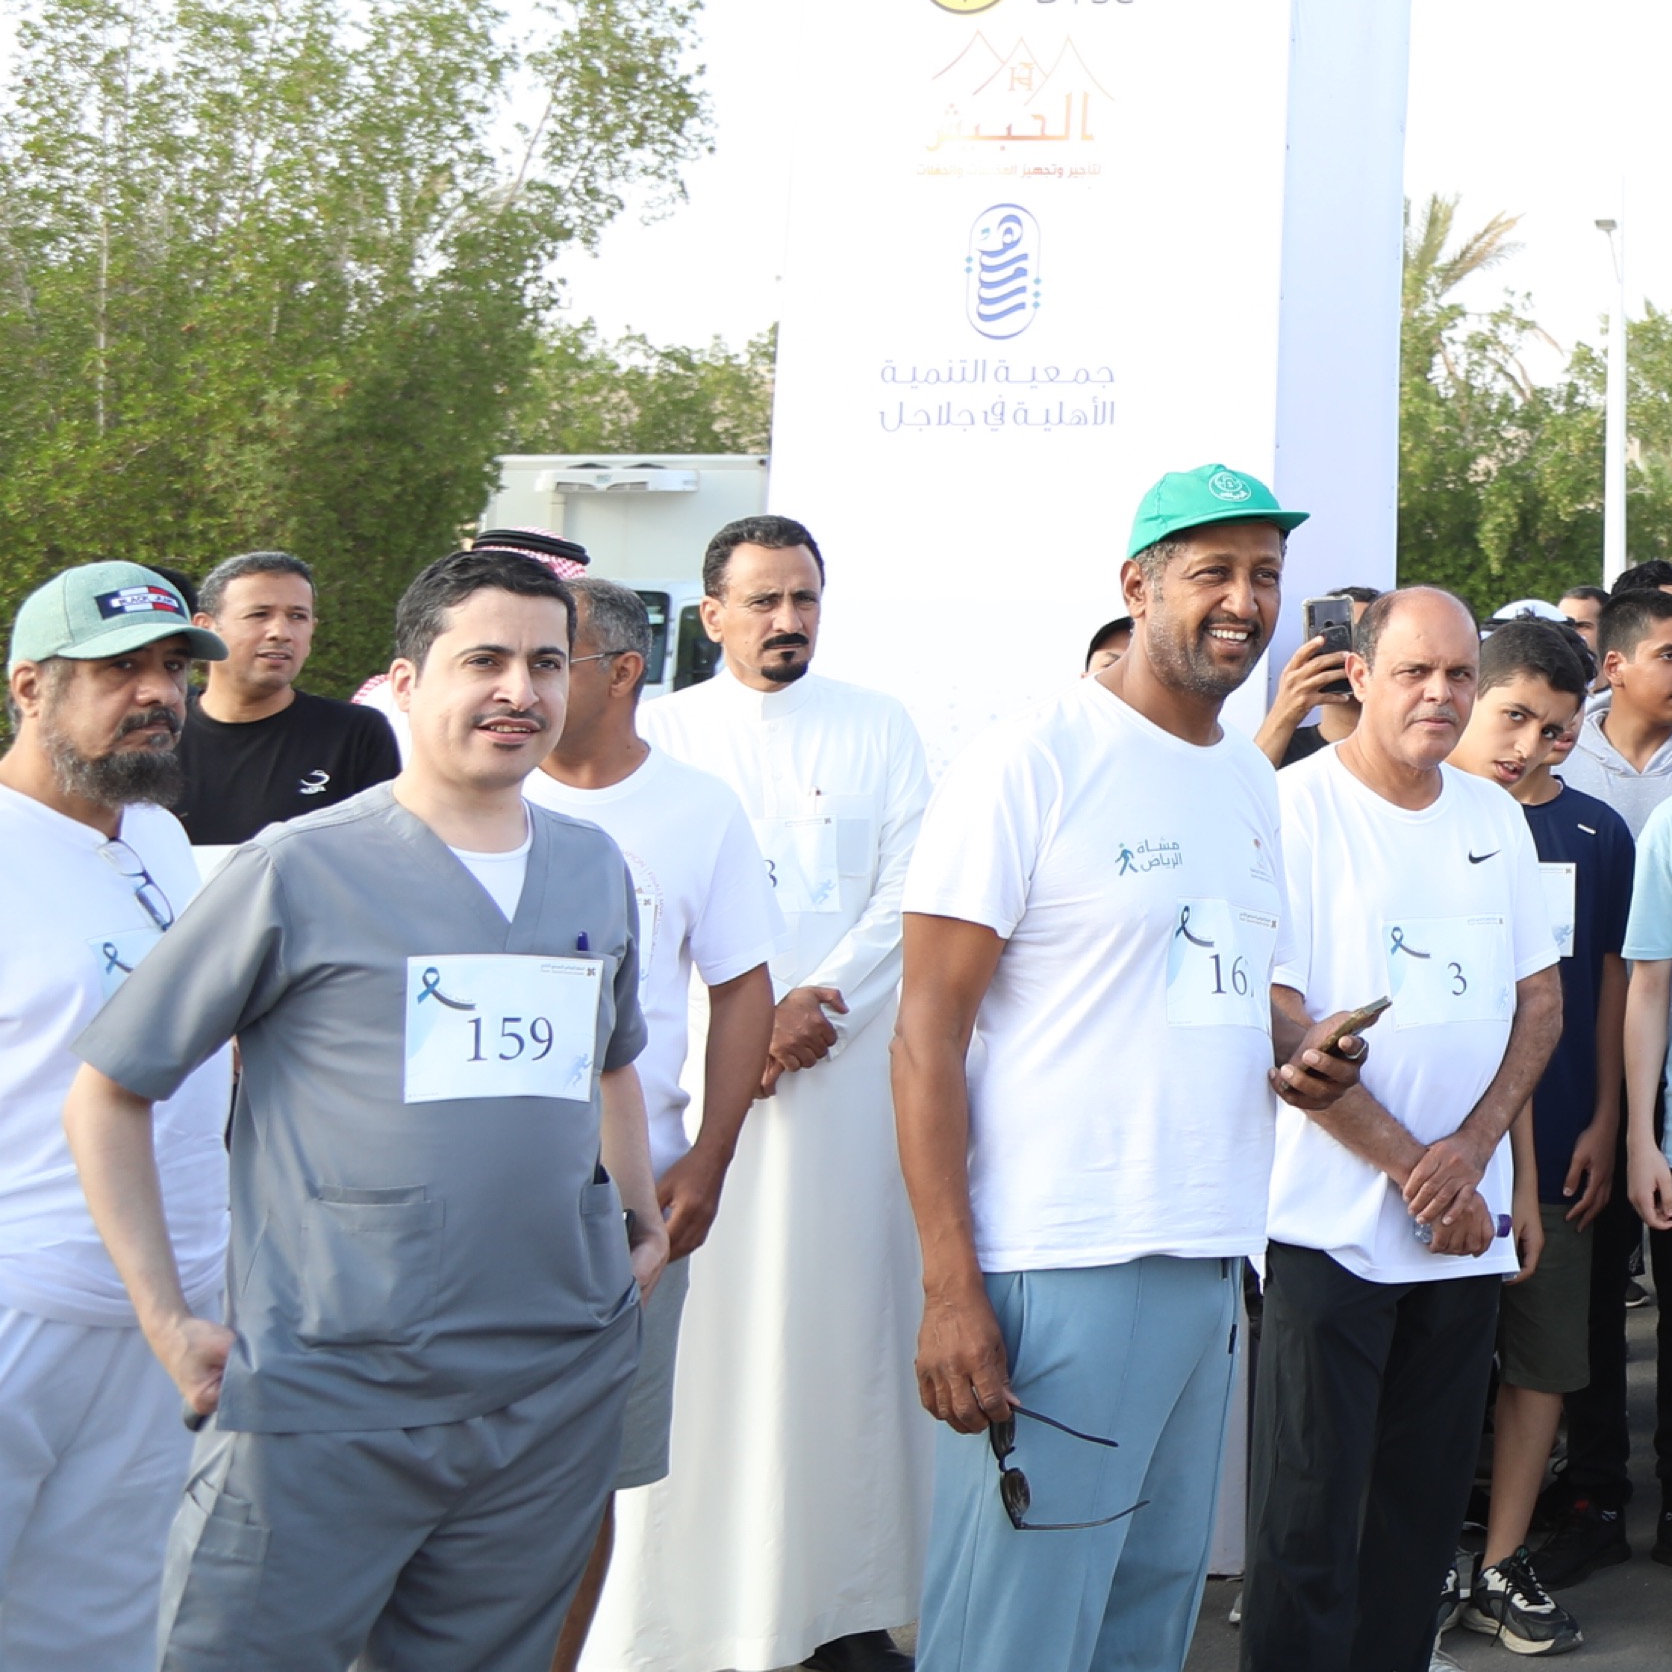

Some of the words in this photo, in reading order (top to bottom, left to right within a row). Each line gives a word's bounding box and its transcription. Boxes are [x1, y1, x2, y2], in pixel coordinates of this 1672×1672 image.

[879, 358, 986, 389] التنمية
[992, 359, 1116, 389] جمعية
[878, 400, 977, 432] جلاجل
[983, 393, 1007, 432] في
[1011, 394, 1116, 432] الأهلية
[1137, 837, 1180, 853] مشاة
[1140, 853, 1183, 872] الرياض
[1209, 953, 1254, 998] 16
[1447, 962, 1467, 996] 3
[466, 1016, 554, 1062] 159
